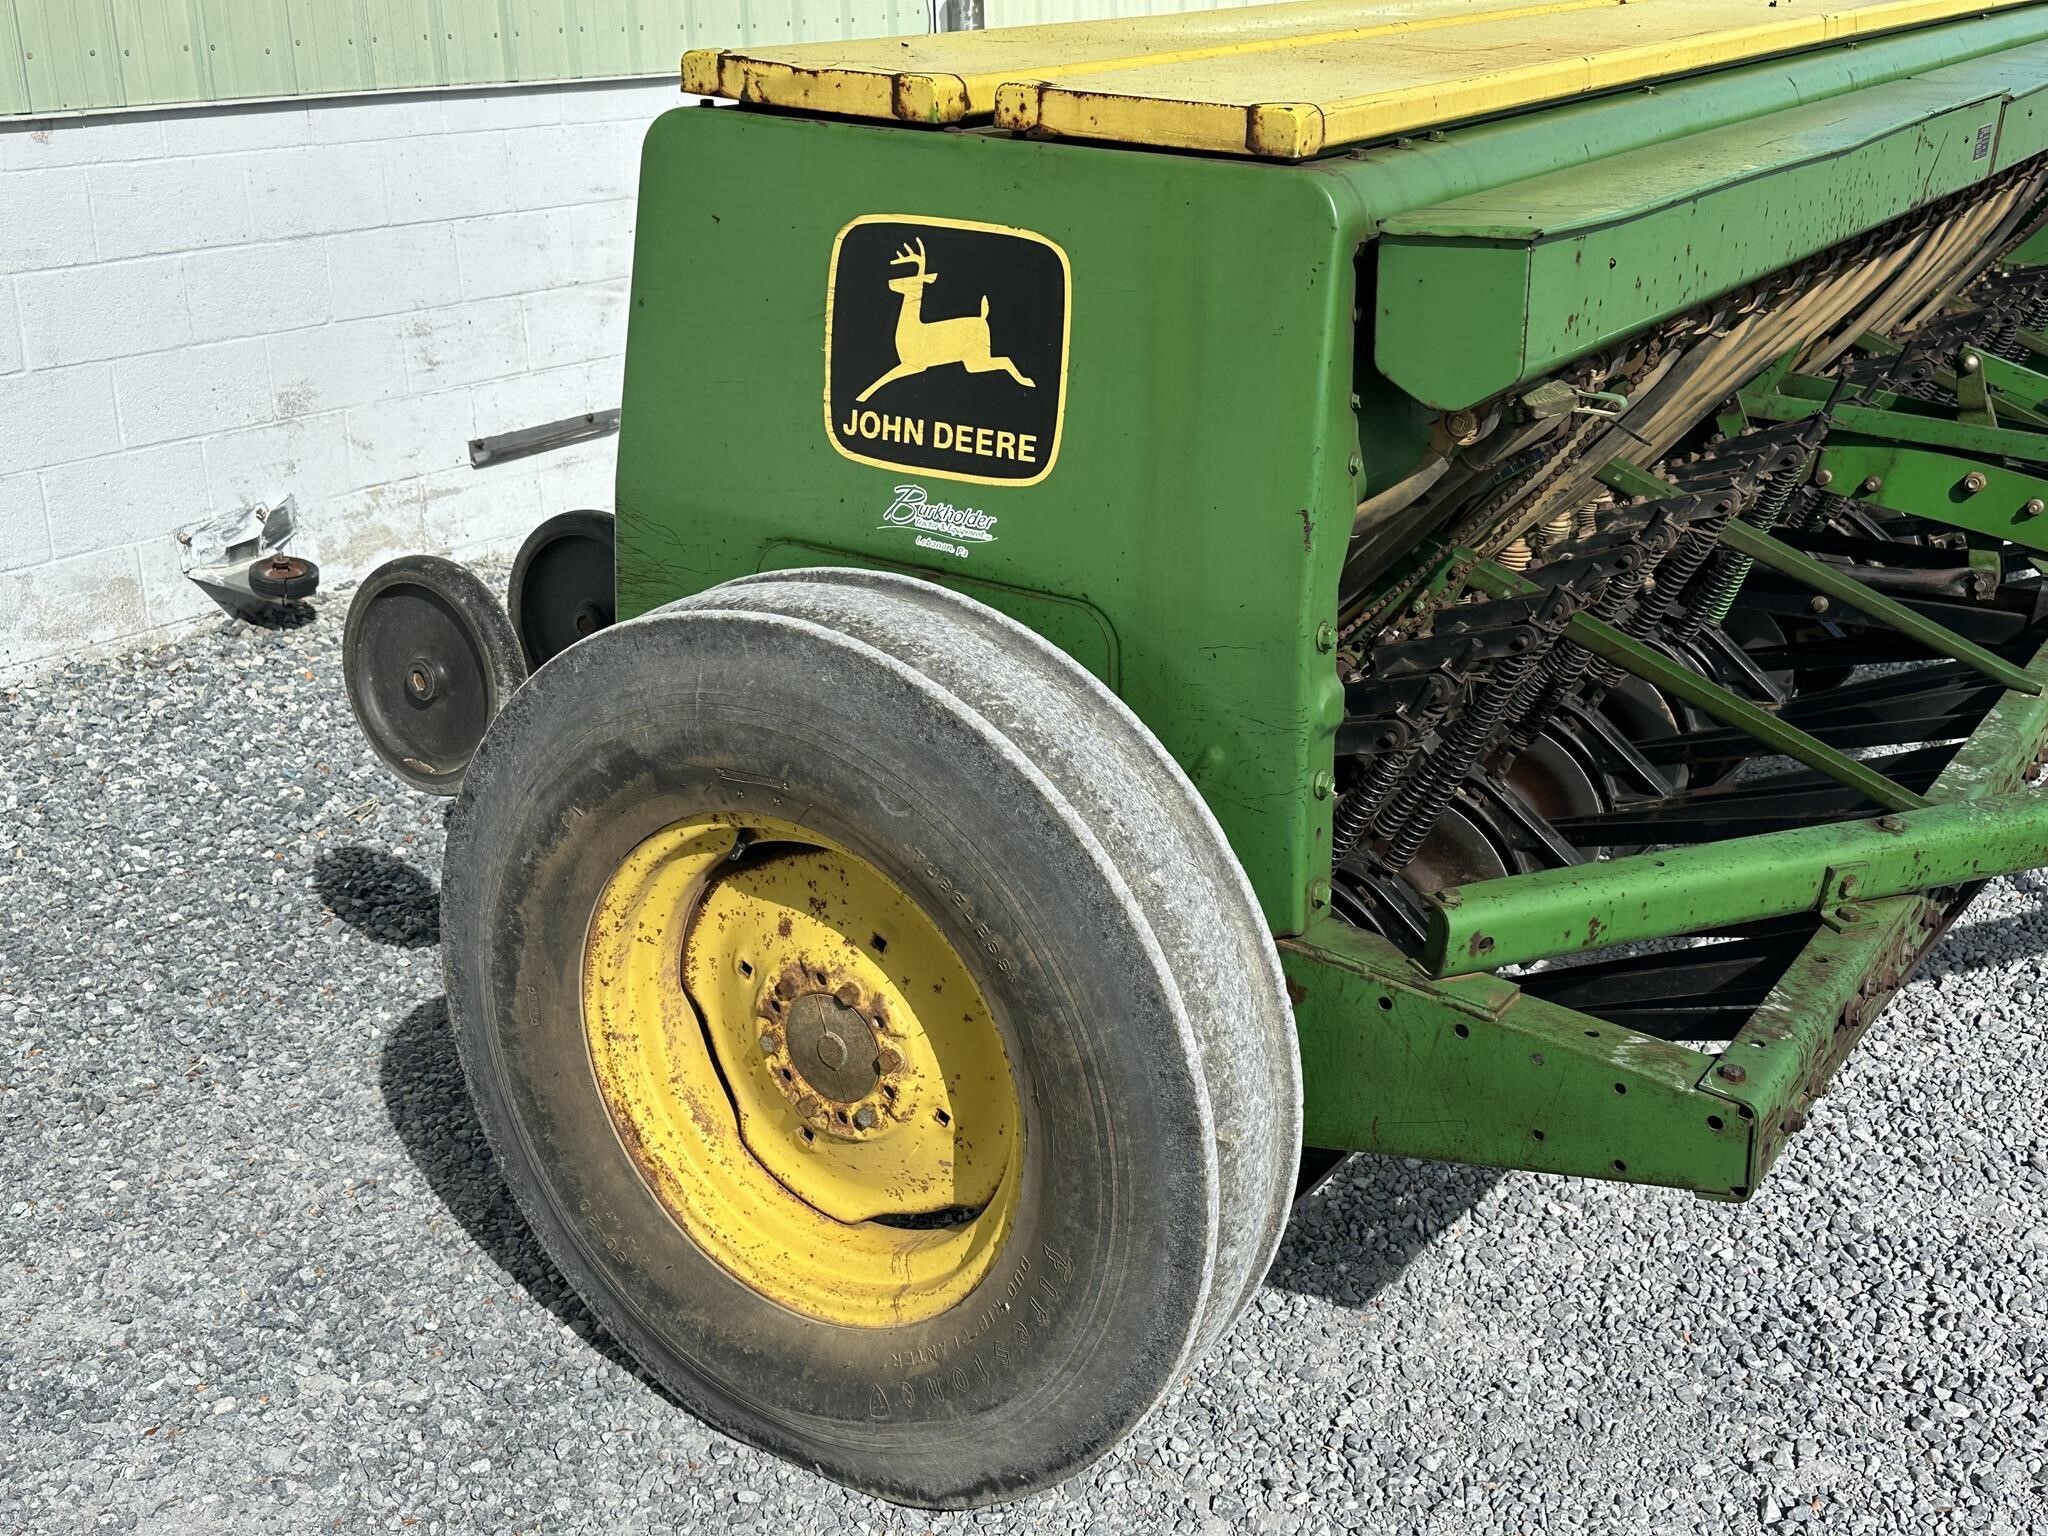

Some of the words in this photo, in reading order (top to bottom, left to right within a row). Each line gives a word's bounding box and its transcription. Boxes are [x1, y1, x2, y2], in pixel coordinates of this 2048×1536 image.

[843, 409, 925, 446] JOHN
[933, 421, 1037, 463] DEERE
[883, 485, 997, 530] Burkholder
[914, 517, 940, 532] Tractor
[947, 522, 986, 539] Equipment
[915, 535, 956, 554] Lebanon,
[955, 544, 969, 558] Pa
